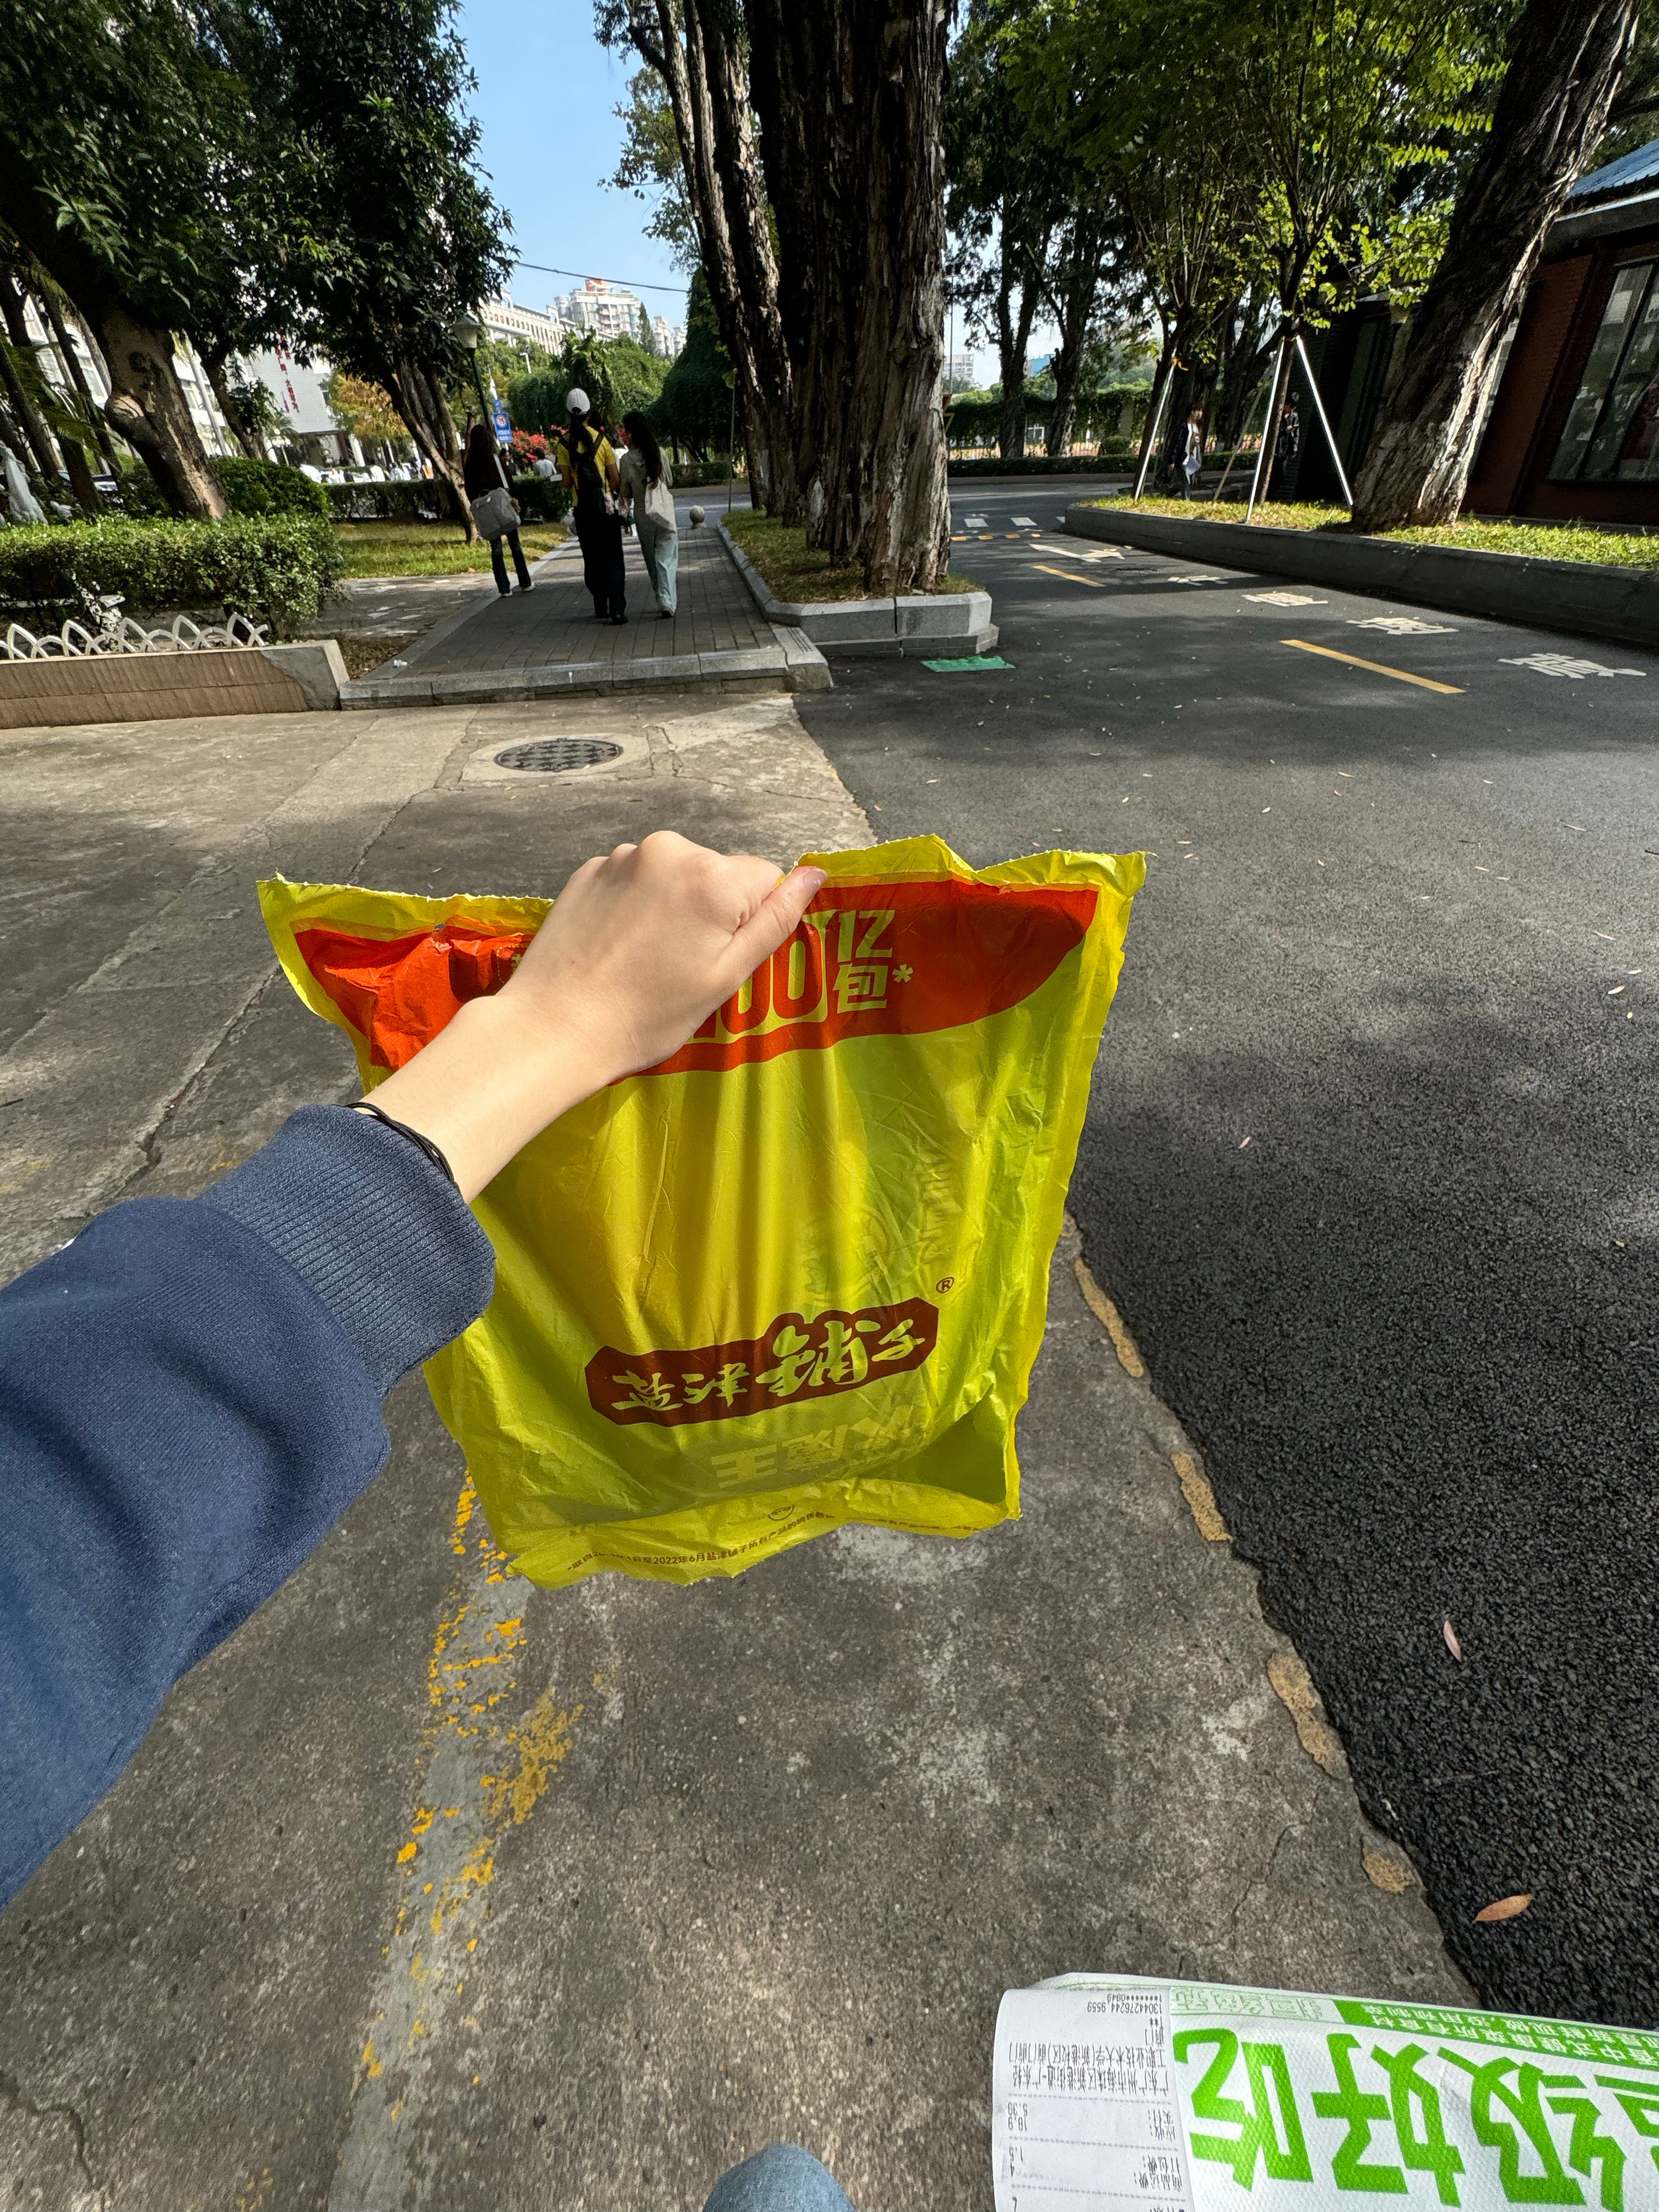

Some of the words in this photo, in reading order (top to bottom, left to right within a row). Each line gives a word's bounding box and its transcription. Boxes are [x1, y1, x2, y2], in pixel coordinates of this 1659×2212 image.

[611, 1318, 926, 1412] 盐津铺子
[1172, 2028, 1659, 2212] 级好吃
